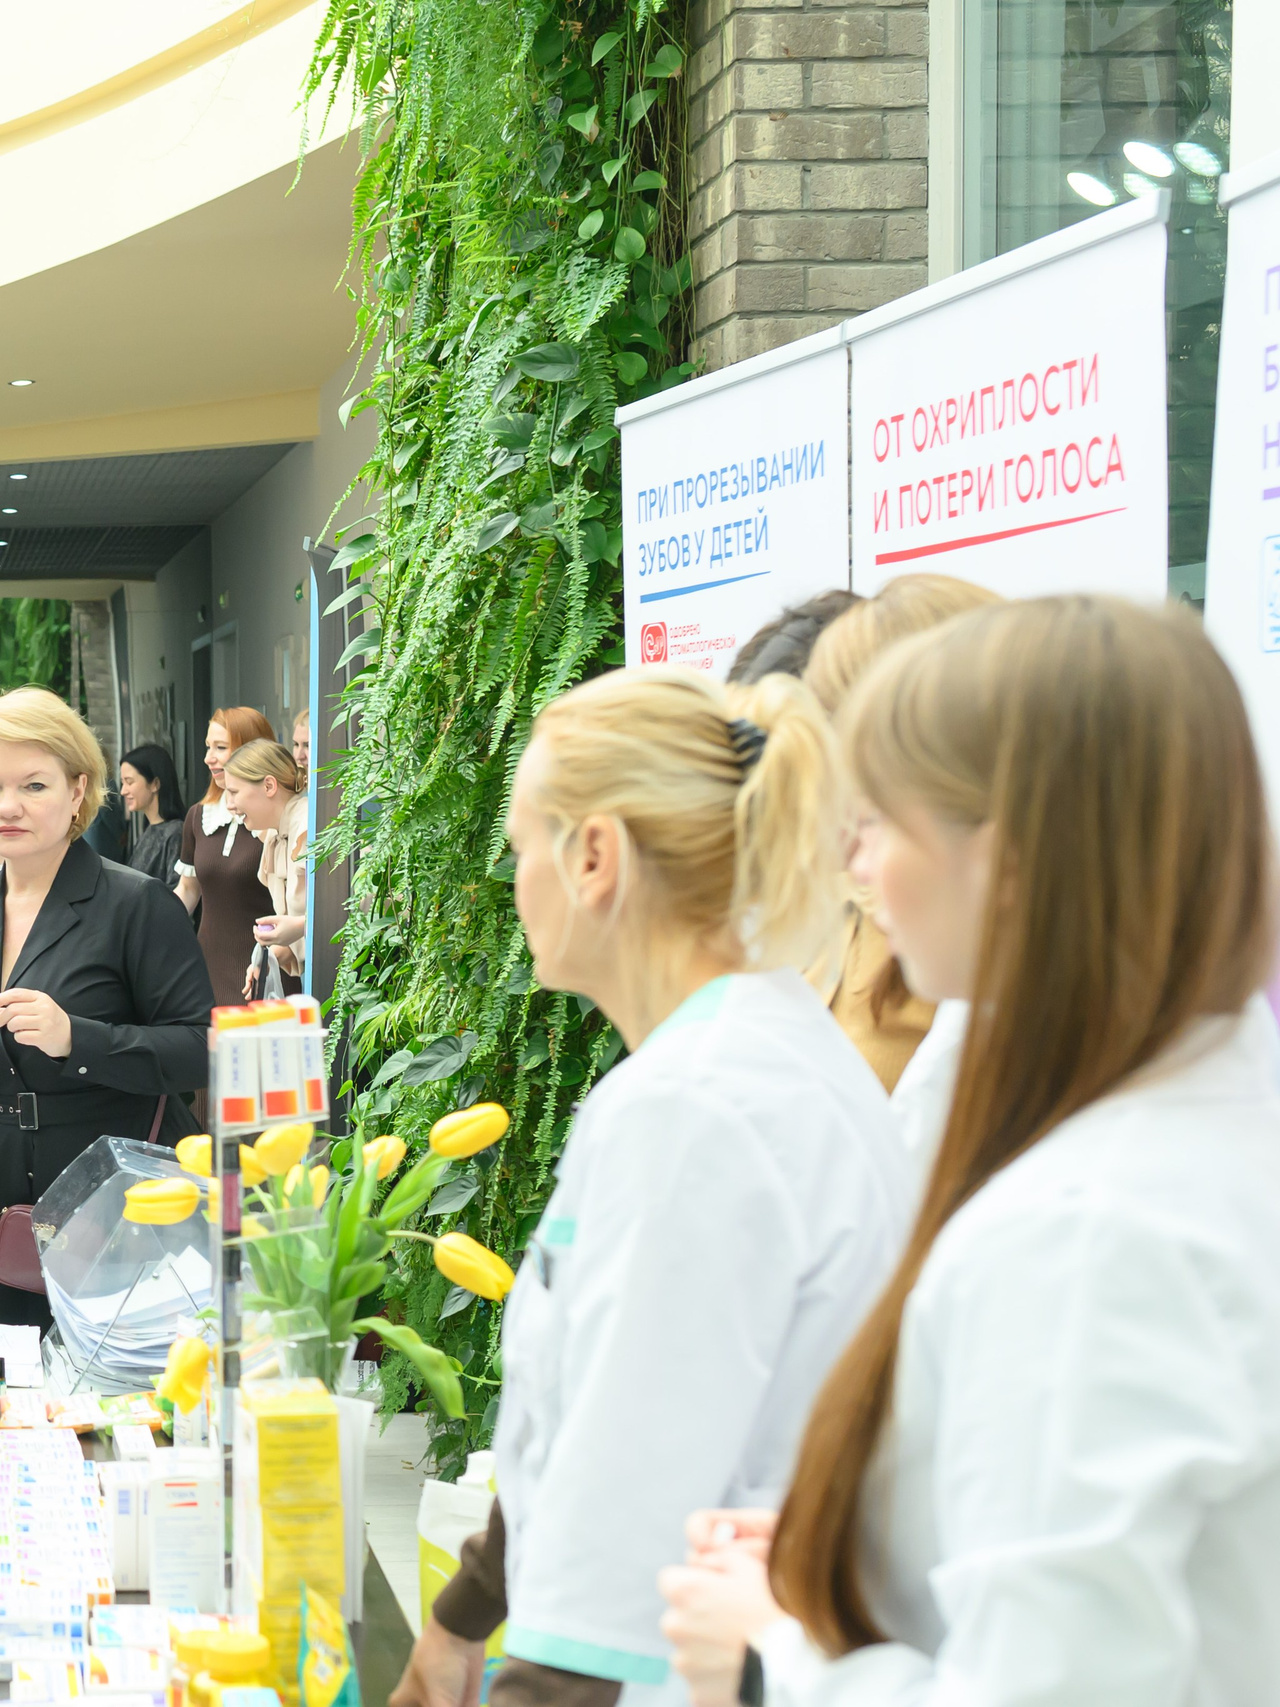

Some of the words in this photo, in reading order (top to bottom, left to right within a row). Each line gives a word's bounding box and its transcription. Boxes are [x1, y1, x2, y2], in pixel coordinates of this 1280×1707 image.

[873, 413, 905, 463] ОТ
[912, 352, 1099, 453] ОХРИПЛОСТИ
[638, 484, 669, 524] ПРИ
[673, 439, 824, 515] ПРОРЕЗЫВАНИИ
[873, 489, 889, 534] И
[898, 462, 995, 529] ПОТЕРИ
[1003, 432, 1125, 506] ГОЛОСА
[638, 533, 691, 577] ЗУБОВ
[694, 529, 705, 565] У
[710, 505, 769, 569] ДЕТЕЙ
